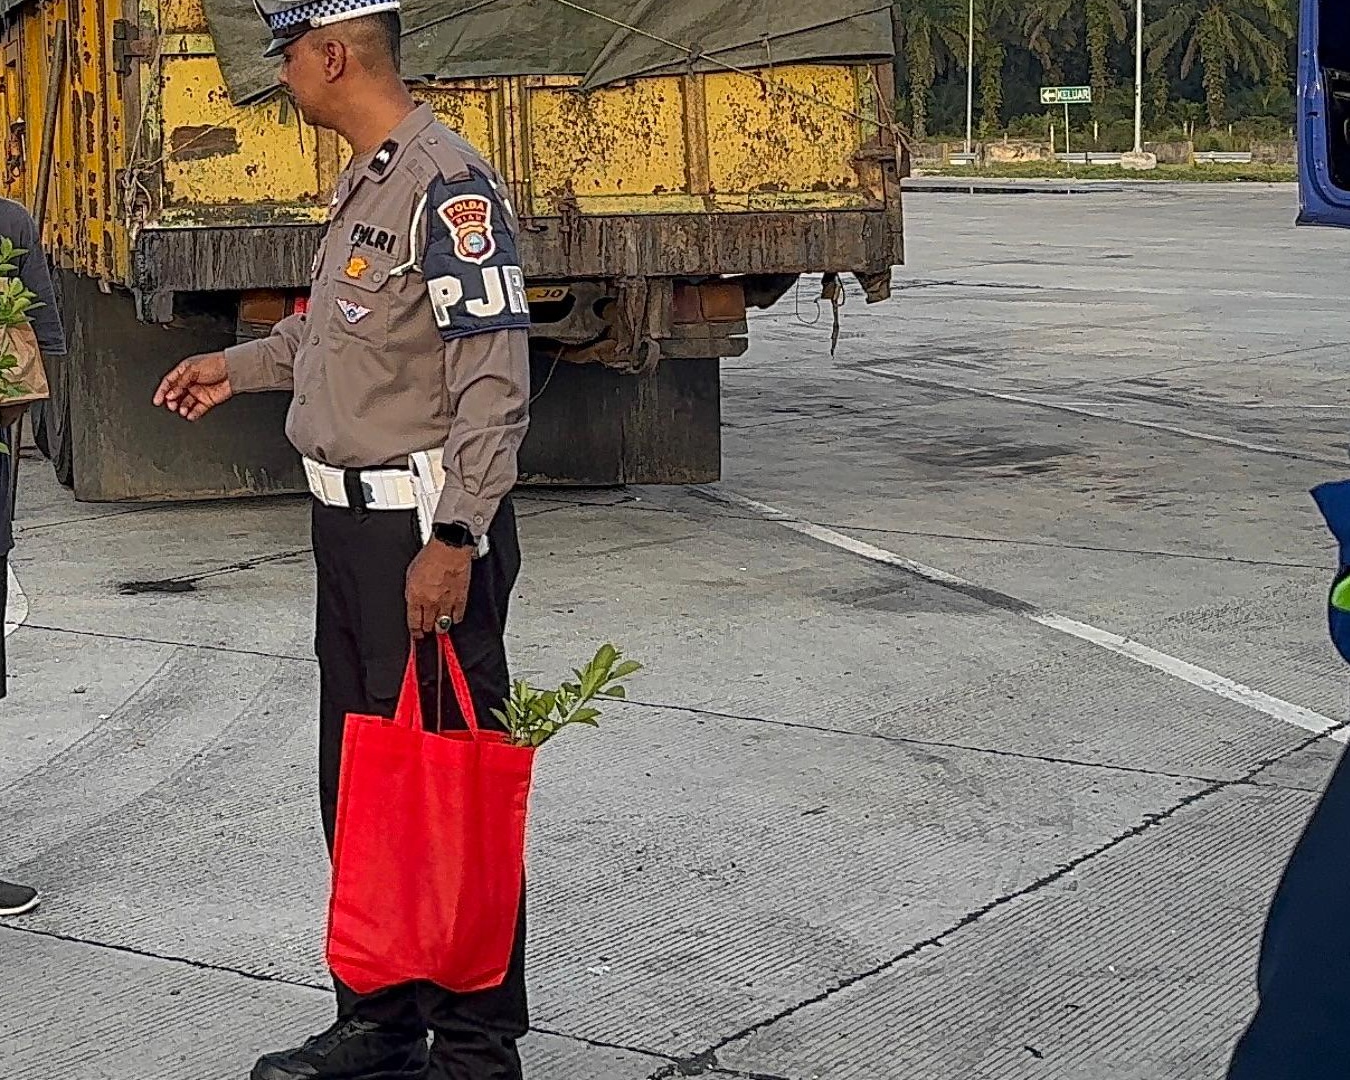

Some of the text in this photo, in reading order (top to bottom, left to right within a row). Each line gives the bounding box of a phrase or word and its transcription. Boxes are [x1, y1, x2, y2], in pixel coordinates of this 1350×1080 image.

[1057, 89, 1090, 100] KELUAR
[446, 200, 485, 217] POLDA
[427, 266, 529, 327] PJR
